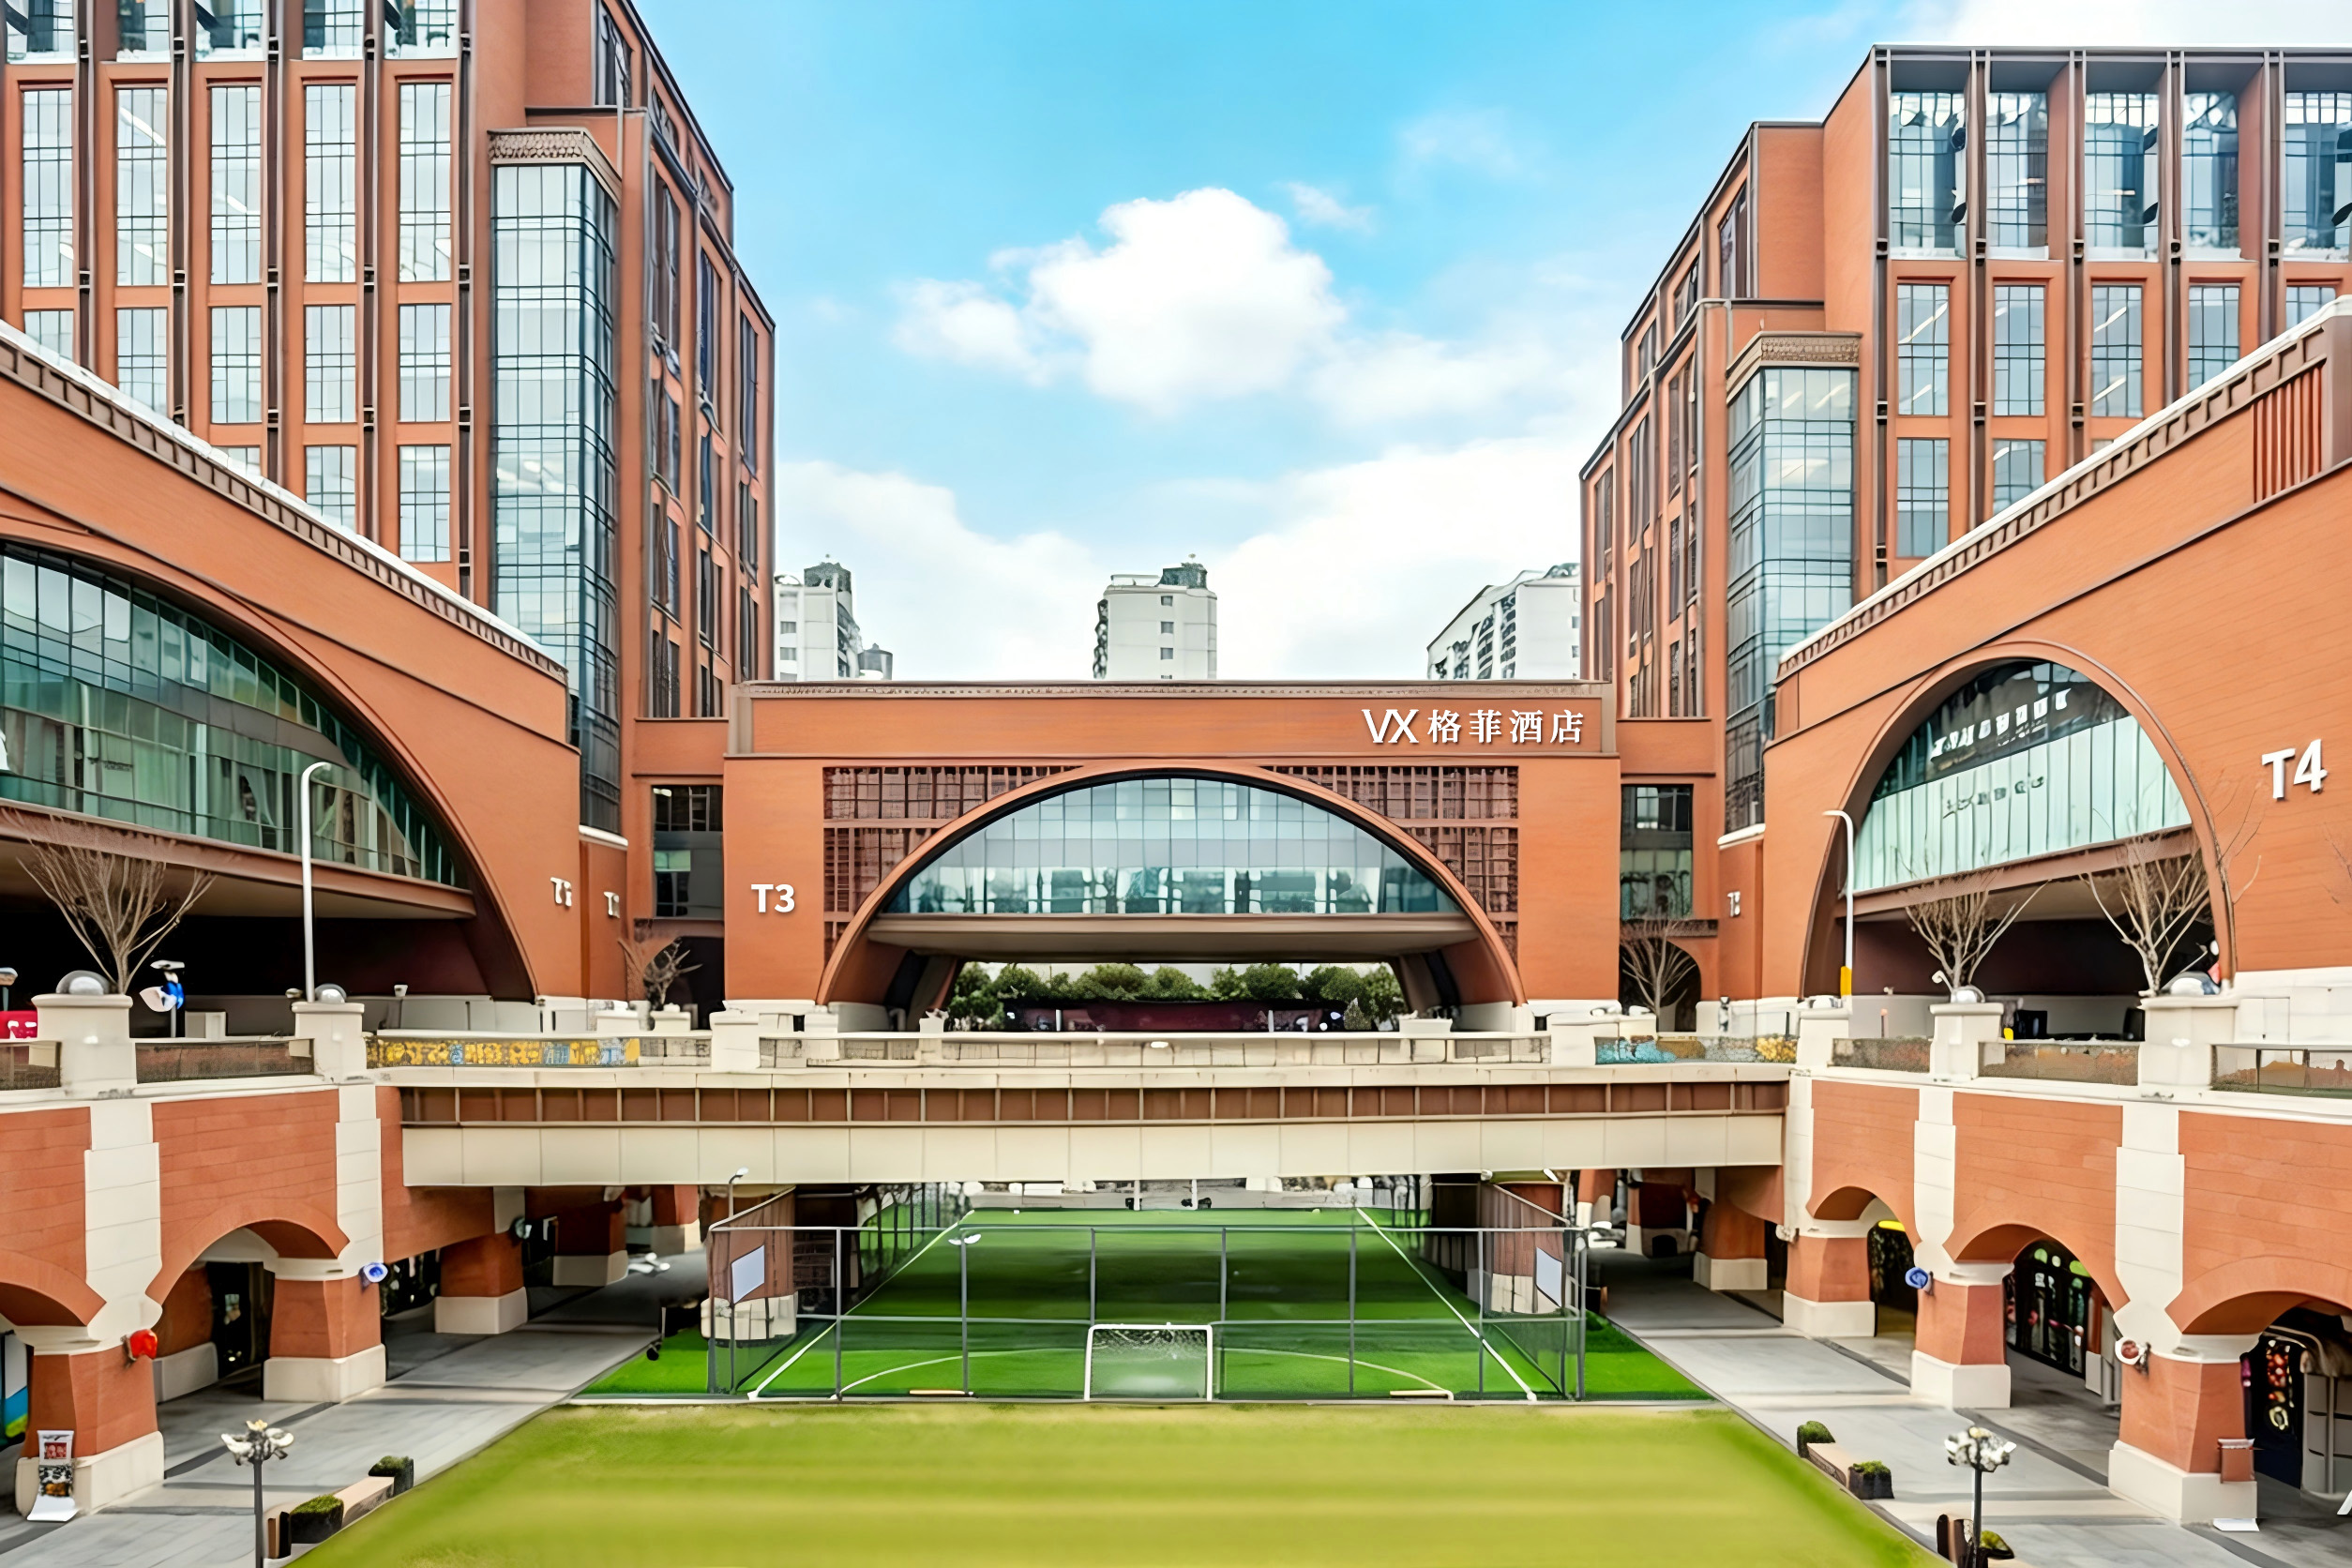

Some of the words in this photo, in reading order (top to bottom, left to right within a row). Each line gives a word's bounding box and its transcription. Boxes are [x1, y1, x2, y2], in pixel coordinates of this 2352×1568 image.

[1361, 709, 1420, 744] VX
[1427, 709, 1584, 744] 格菲酒店
[2261, 738, 2329, 800] T4
[750, 883, 795, 913] T3
